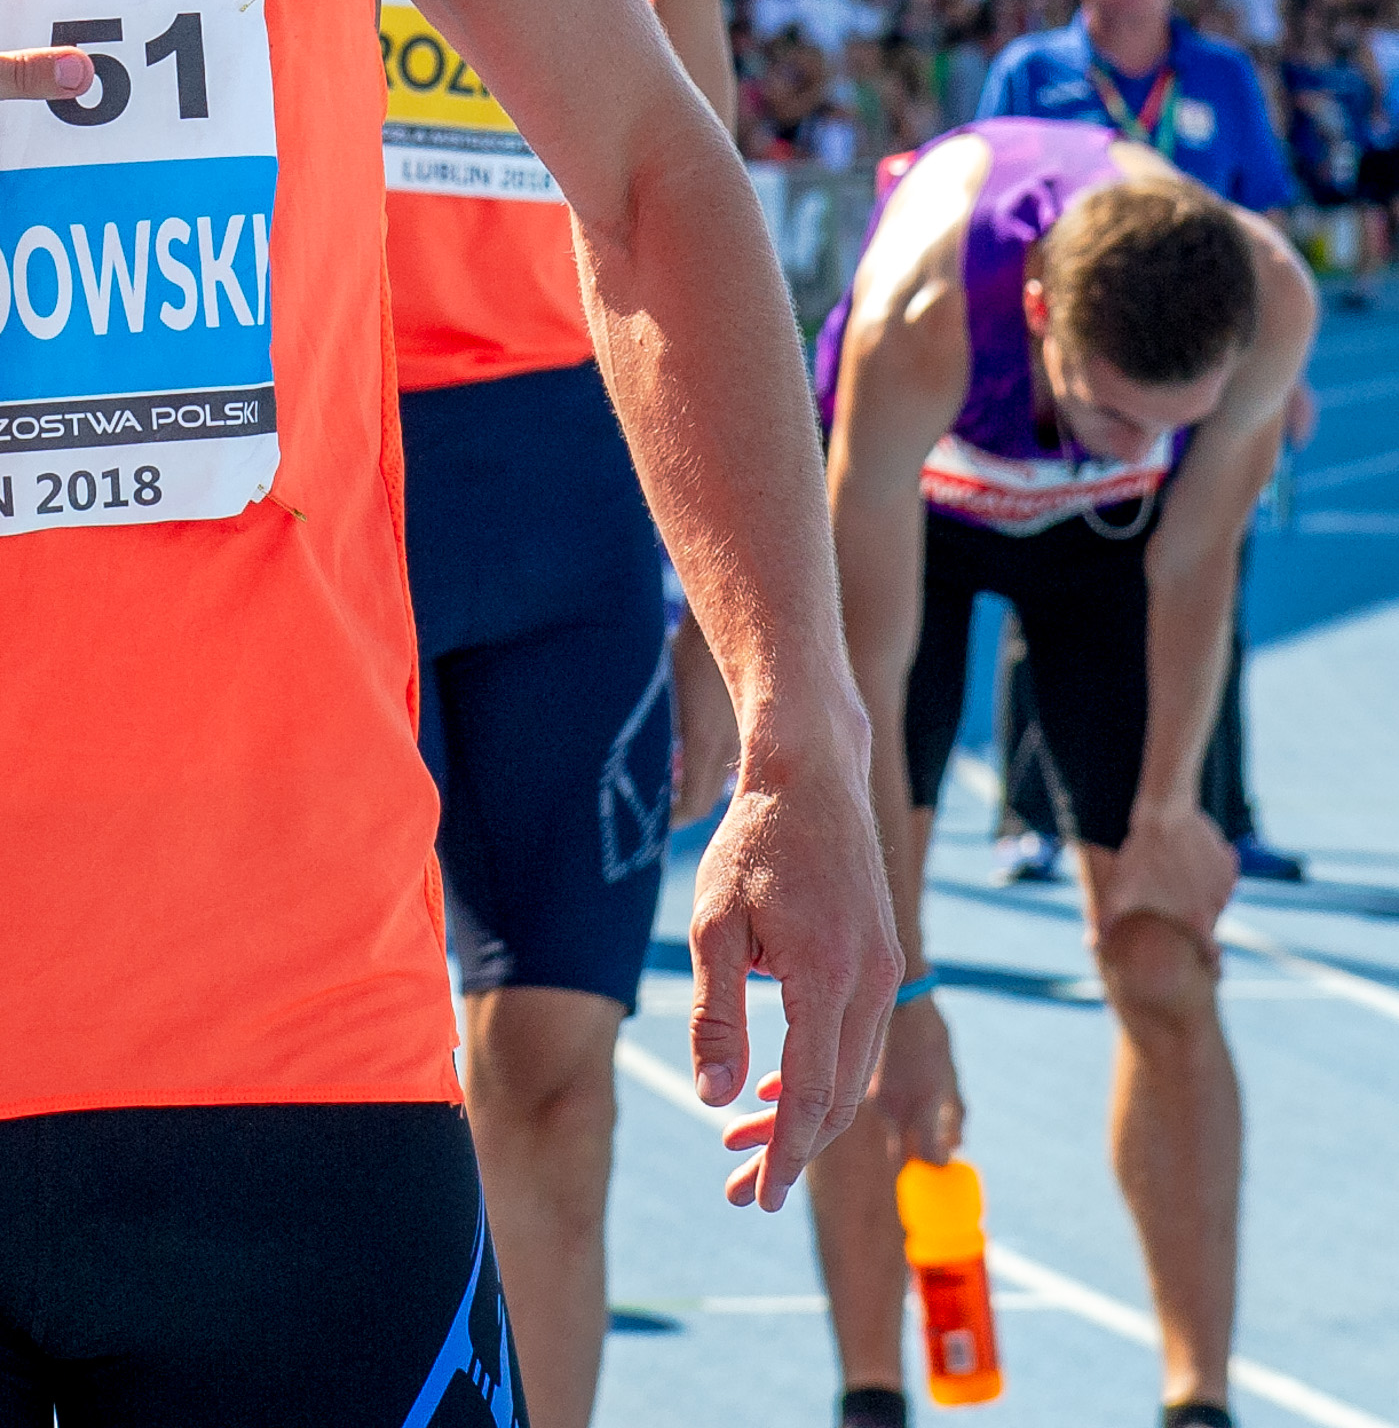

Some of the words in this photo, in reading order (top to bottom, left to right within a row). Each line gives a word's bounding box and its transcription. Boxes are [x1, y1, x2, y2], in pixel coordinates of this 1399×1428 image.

[46, 13, 209, 127] 51
[151, 400, 259, 430] POLSKI
[36, 465, 163, 515] 2018
